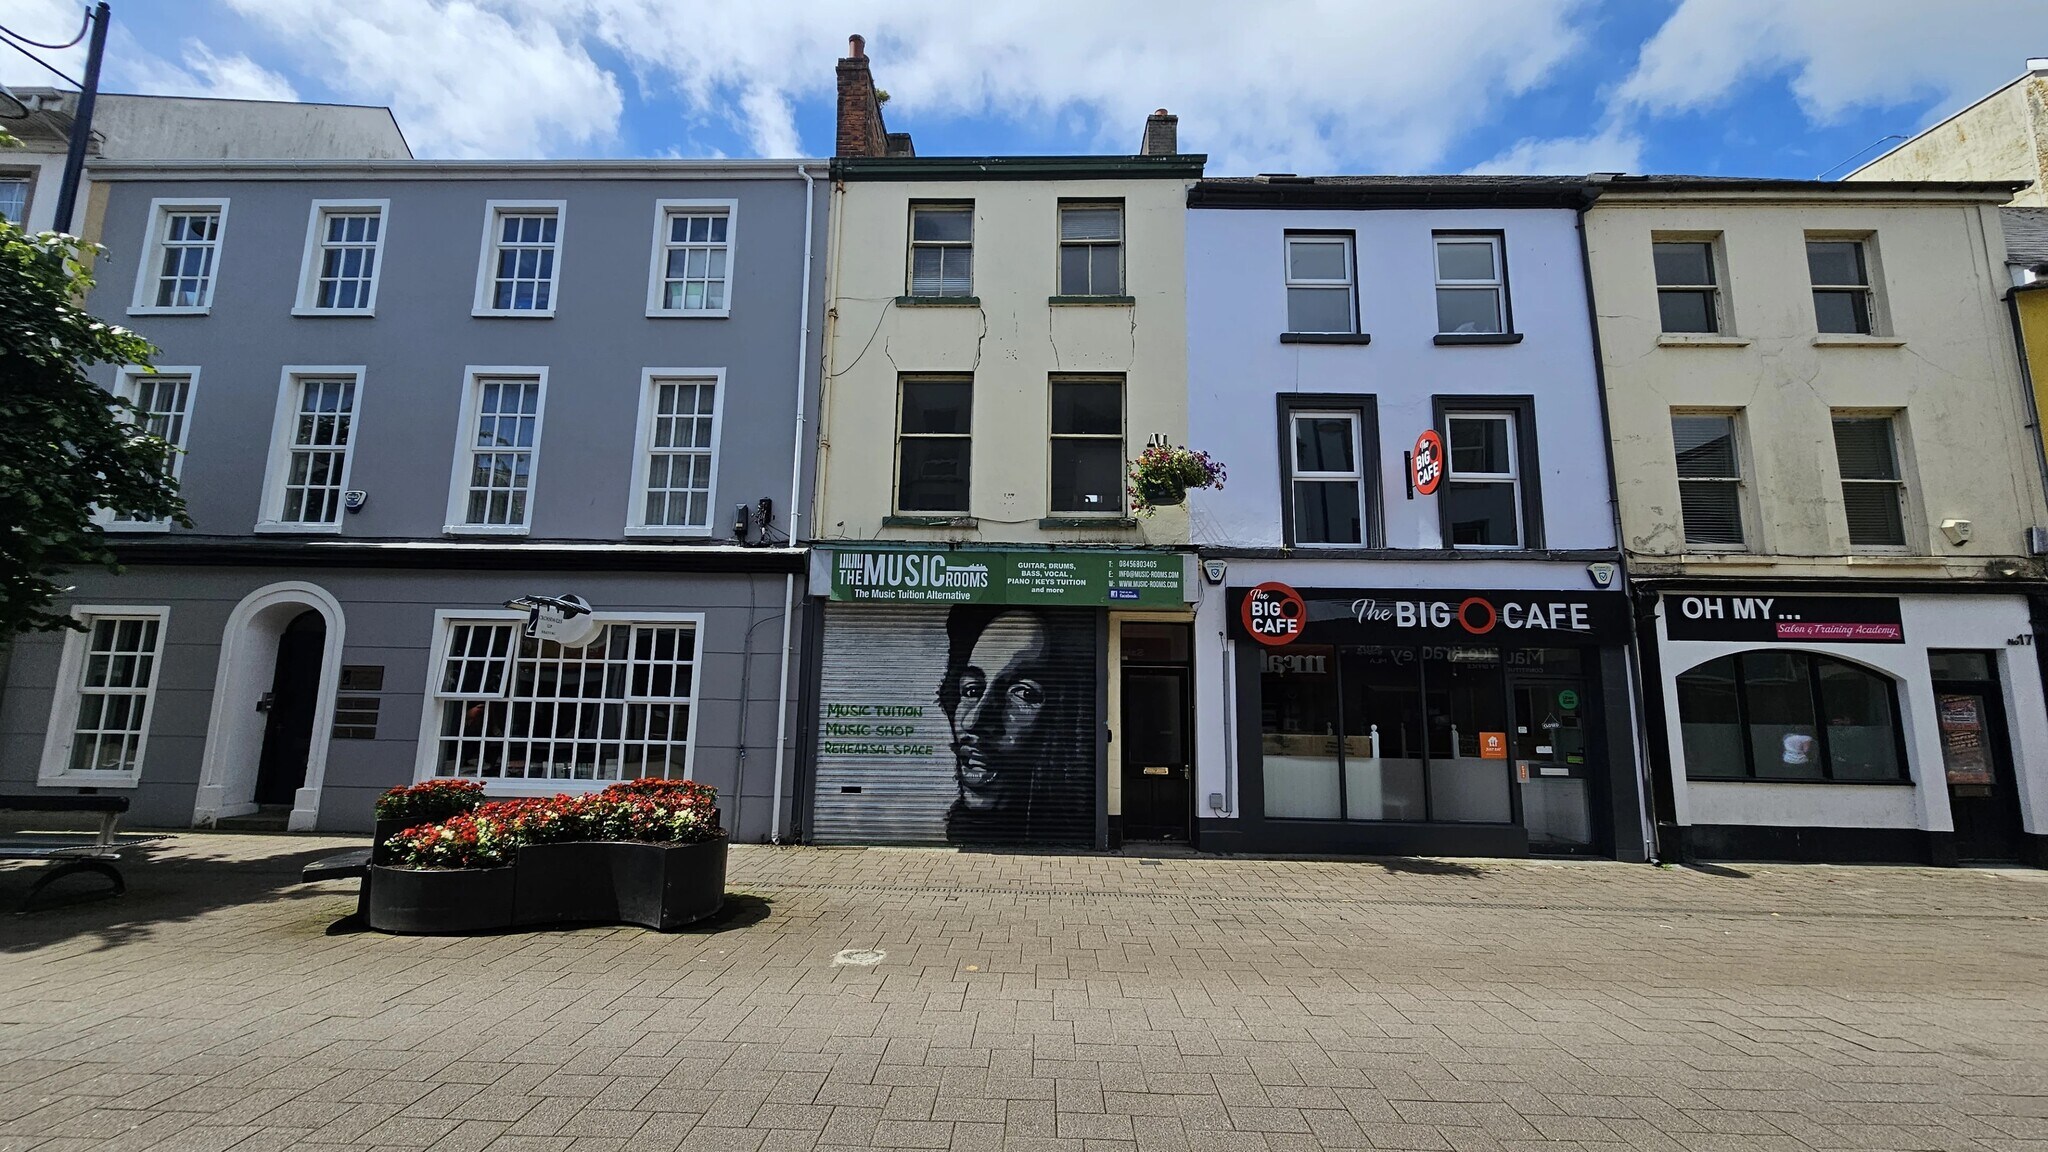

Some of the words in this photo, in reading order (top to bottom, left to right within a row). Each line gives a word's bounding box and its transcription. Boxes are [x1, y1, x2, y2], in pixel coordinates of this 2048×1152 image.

[1420, 439, 1429, 451] The
[1416, 451, 1430, 470] BIG
[1418, 461, 1439, 485] CAFE
[839, 570, 862, 585] THE
[864, 554, 946, 587] MUSIC
[946, 572, 988, 588] ROOMS
[855, 589, 869, 598] The
[872, 589, 896, 599] Music
[898, 590, 924, 599] Tuition
[926, 590, 970, 600] Alternative
[1250, 589, 1269, 600] The
[1252, 602, 1280, 616] BIG
[1351, 598, 1392, 624] The
[1396, 601, 1450, 628] BIG
[1503, 603, 1590, 629] CAFE
[1682, 597, 1724, 619] OH
[1252, 618, 1298, 633] CAFE
[1779, 624, 1804, 633] Salon
[1814, 625, 1852, 635] Training
[1856, 625, 1899, 637] Academy
[827, 703, 871, 717] MUSIC
[874, 706, 923, 717] TUITION
[826, 722, 871, 736] MUSIC
[876, 726, 914, 736] SHOP
[824, 741, 889, 754] REHEARSAL
[894, 744, 933, 755] SPACE
